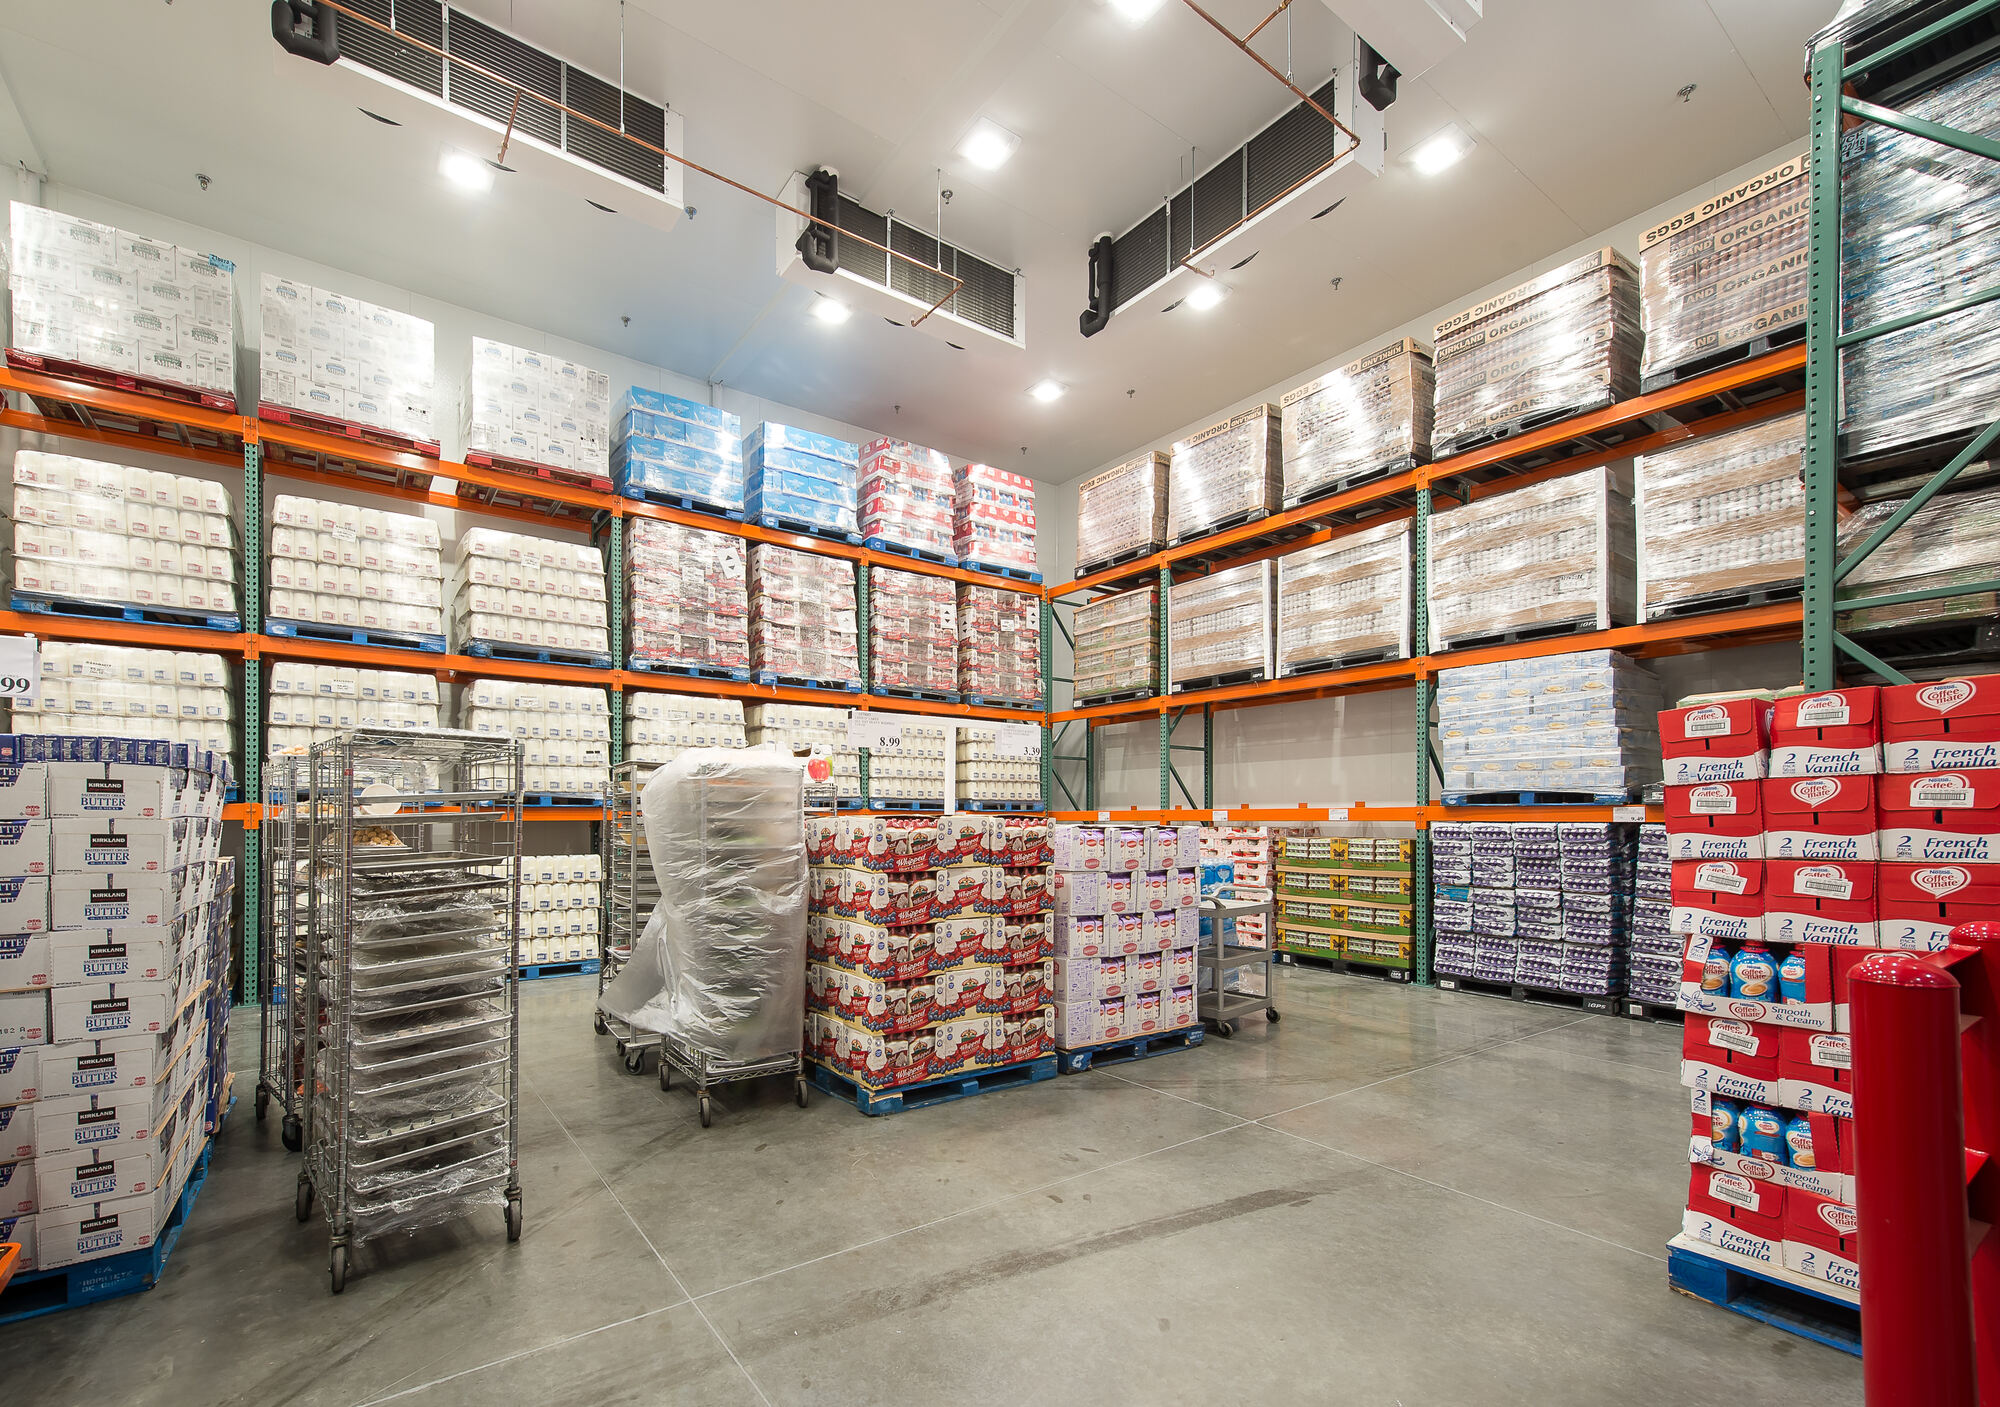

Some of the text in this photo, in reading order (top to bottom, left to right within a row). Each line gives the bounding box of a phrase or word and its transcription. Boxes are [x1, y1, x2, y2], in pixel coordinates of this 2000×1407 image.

[1646, 165, 1795, 243] ORGANIC EGGS
[1720, 197, 1810, 245] ORGANIC
[1437, 314, 1470, 334] EGGS
[1439, 333, 1484, 358] KIRKLAND
[1362, 345, 1402, 367] KIRKLAND
[1284, 388, 1309, 404] EGGS
[1193, 422, 1228, 443] ORGANIC
[1096, 467, 1124, 484] ORGANIC
[1936, 693, 1963, 704] mate
[880, 736, 900, 747] 8.99
[1024, 746, 1040, 756] 3.39
[1905, 748, 1919, 760] 2
[1933, 745, 1996, 758] French
[1784, 753, 1796, 764] 2
[1808, 752, 1859, 763] French
[1931, 757, 1997, 769] Vanilla
[1678, 763, 1688, 774] 2
[1699, 760, 1743, 771] French
[1805, 762, 1860, 773] Vanilla
[1697, 770, 1744, 781] Vanilla
[1808, 790, 1830, 798] mate
[81, 797, 126, 806] BUTTER
[1681, 839, 1691, 849] 2
[1702, 839, 1746, 849] French
[1780, 838, 1792, 848] 2
[1804, 838, 1856, 848] French
[1898, 836, 1912, 847] 2
[1926, 837, 1988, 847] French
[1013, 850, 1038, 860] Whipped
[1700, 849, 1748, 858] Vanilla
[1802, 848, 1857, 858] Vanilla
[1924, 848, 1988, 859] Vanilla
[896, 853, 926, 866] Whipped
[1013, 899, 1038, 909] Whipped
[84, 907, 129, 916] BUTTER
[898, 905, 927, 920] Whipped
[1682, 913, 1692, 924] 2
[1702, 917, 1747, 928] French
[1781, 919, 1793, 930] 2
[1805, 923, 1858, 935] French
[1700, 926, 1748, 938] Vanilla
[1901, 928, 1916, 939] 2
[1694, 938, 1708, 950] 2
[1802, 932, 1858, 945] Vanilla
[1013, 948, 1037, 958] Whipped
[83, 962, 129, 972] BUTTER
[898, 960, 925, 973] Whipped
[1013, 994, 1037, 1008] Whipped
[1772, 1006, 1811, 1017] Smooth
[86, 1016, 131, 1028] BUTTER
[896, 1011, 925, 1025] Whipped
[1785, 1015, 1825, 1027] Creamy
[1013, 1041, 1037, 1056] Whipped
[896, 1064, 925, 1079] Whipped
[1697, 1069, 1708, 1079] 2
[72, 1072, 118, 1084] BUTTER
[1718, 1075, 1766, 1092] French
[1695, 1090, 1706, 1101] 2
[1716, 1084, 1766, 1102] Vanilla
[1800, 1089, 1812, 1100] 2
[79, 1110, 114, 1120] KIRKLAND
[74, 1126, 120, 1141] BUTTER
[78, 1164, 112, 1175] KIRKLAND
[1780, 1168, 1820, 1184] Smooth
[71, 1179, 117, 1195] BUTTER
[1794, 1179, 1833, 1196] Creamy
[82, 1218, 116, 1229] KIRKLAND
[1701, 1221, 1712, 1233] 2
[77, 1234, 123, 1251] BUTTER
[1722, 1230, 1770, 1251] French
[1720, 1239, 1770, 1262] Vanilla
[1802, 1252, 1815, 1265] 2
